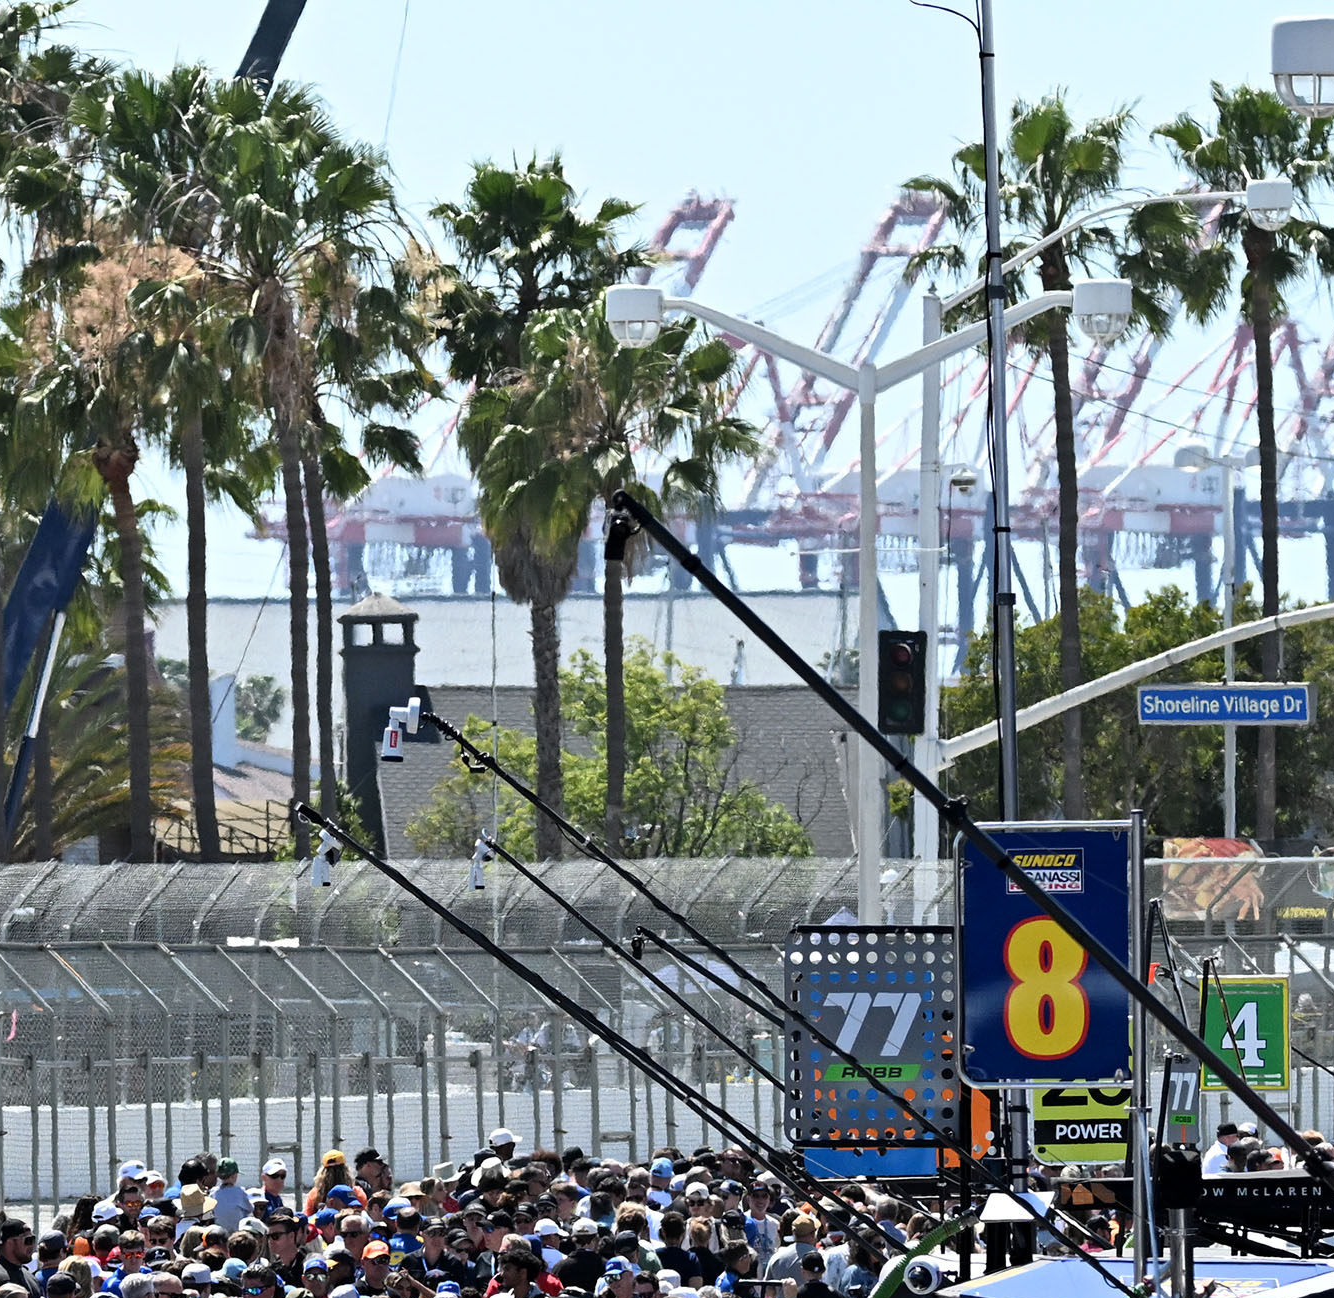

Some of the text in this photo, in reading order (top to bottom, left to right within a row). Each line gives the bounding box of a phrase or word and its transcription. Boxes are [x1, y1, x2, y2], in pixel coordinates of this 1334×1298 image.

[1143, 695, 1302, 718] Shoreline Village Dr
[1012, 854, 1078, 867] SUNOCO
[1003, 915, 1090, 1060] 8
[822, 992, 922, 1057] 77
[1221, 1001, 1267, 1067] 4
[841, 1067, 903, 1079] ROBB
[1170, 1072, 1197, 1110] 77
[1055, 1123, 1123, 1140] POWER
[1236, 1186, 1323, 1197] McLAREN
